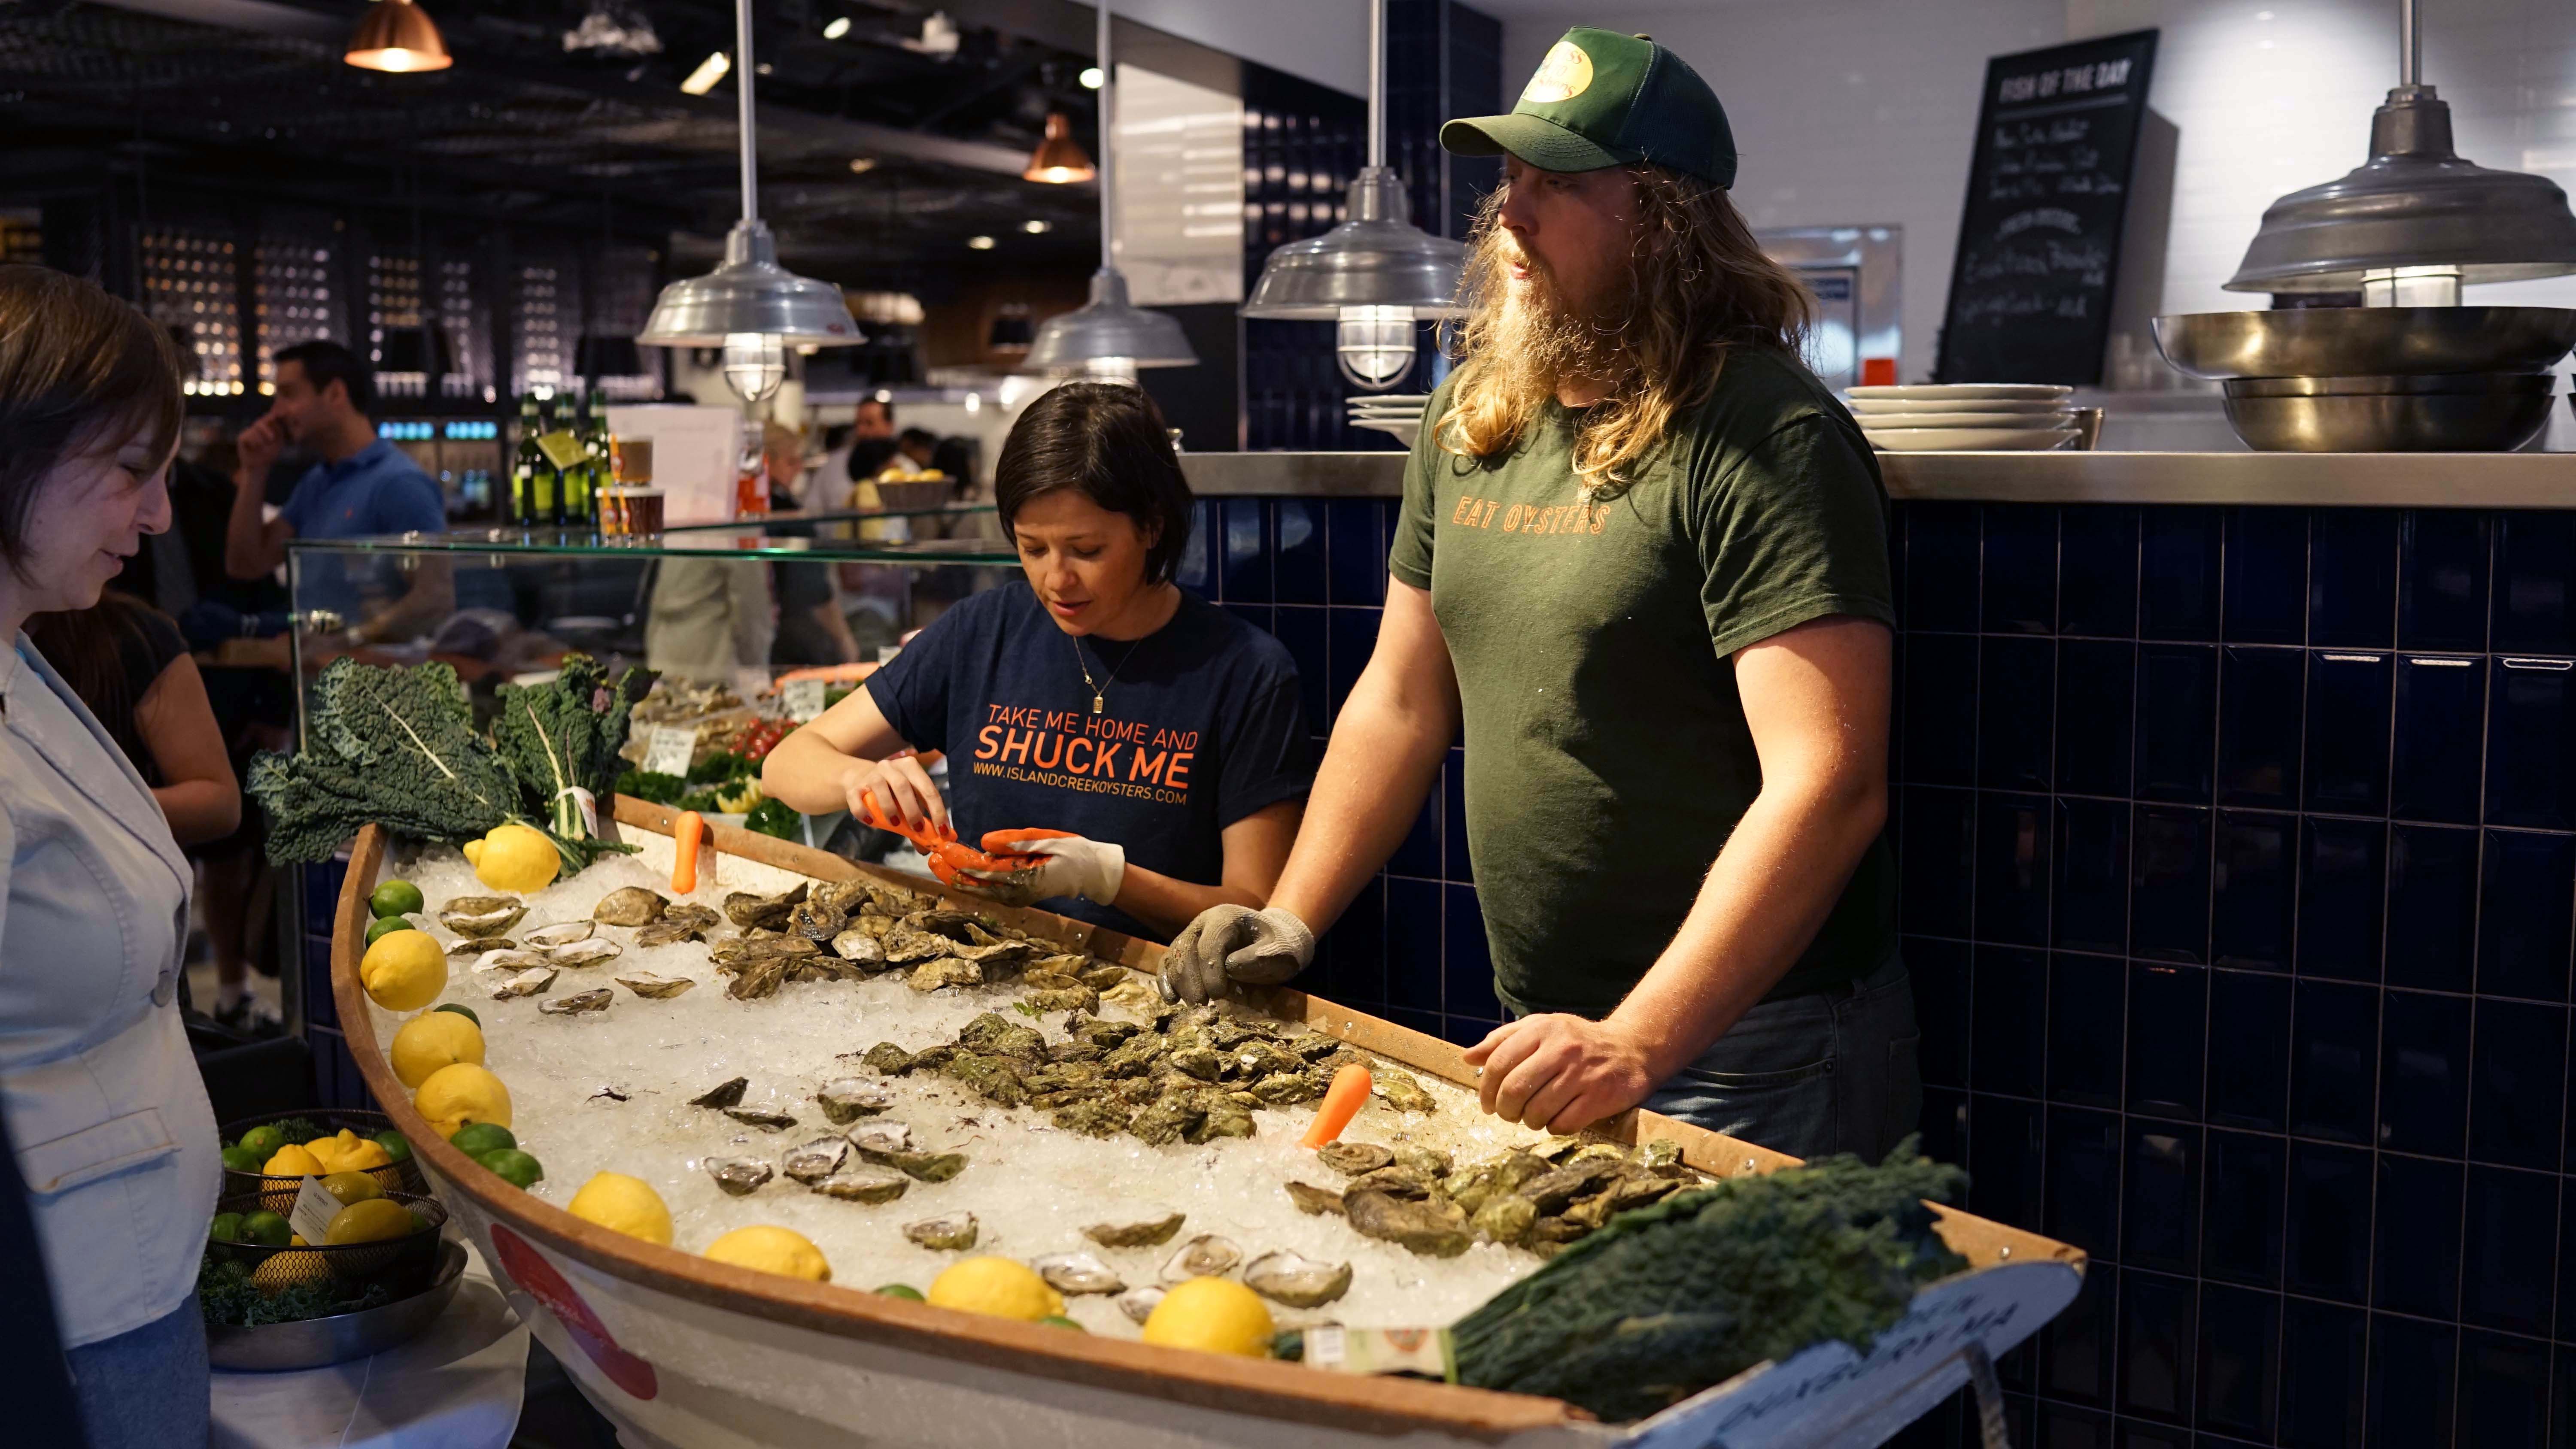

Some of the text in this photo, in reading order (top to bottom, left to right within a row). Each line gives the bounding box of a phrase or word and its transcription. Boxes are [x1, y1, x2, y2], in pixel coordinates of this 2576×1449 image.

[2038, 70, 2060, 97] OF
[2062, 65, 2094, 93] THE
[2096, 58, 2131, 88] DAY
[1452, 496, 1610, 535] EAT OYSTERS
[989, 704, 1198, 750] TAKE ME HOME AND
[974, 725, 1194, 789] SHUCK ME
[973, 763, 1187, 805] WWW.ISLANDCREEKOYSTERS.COM
